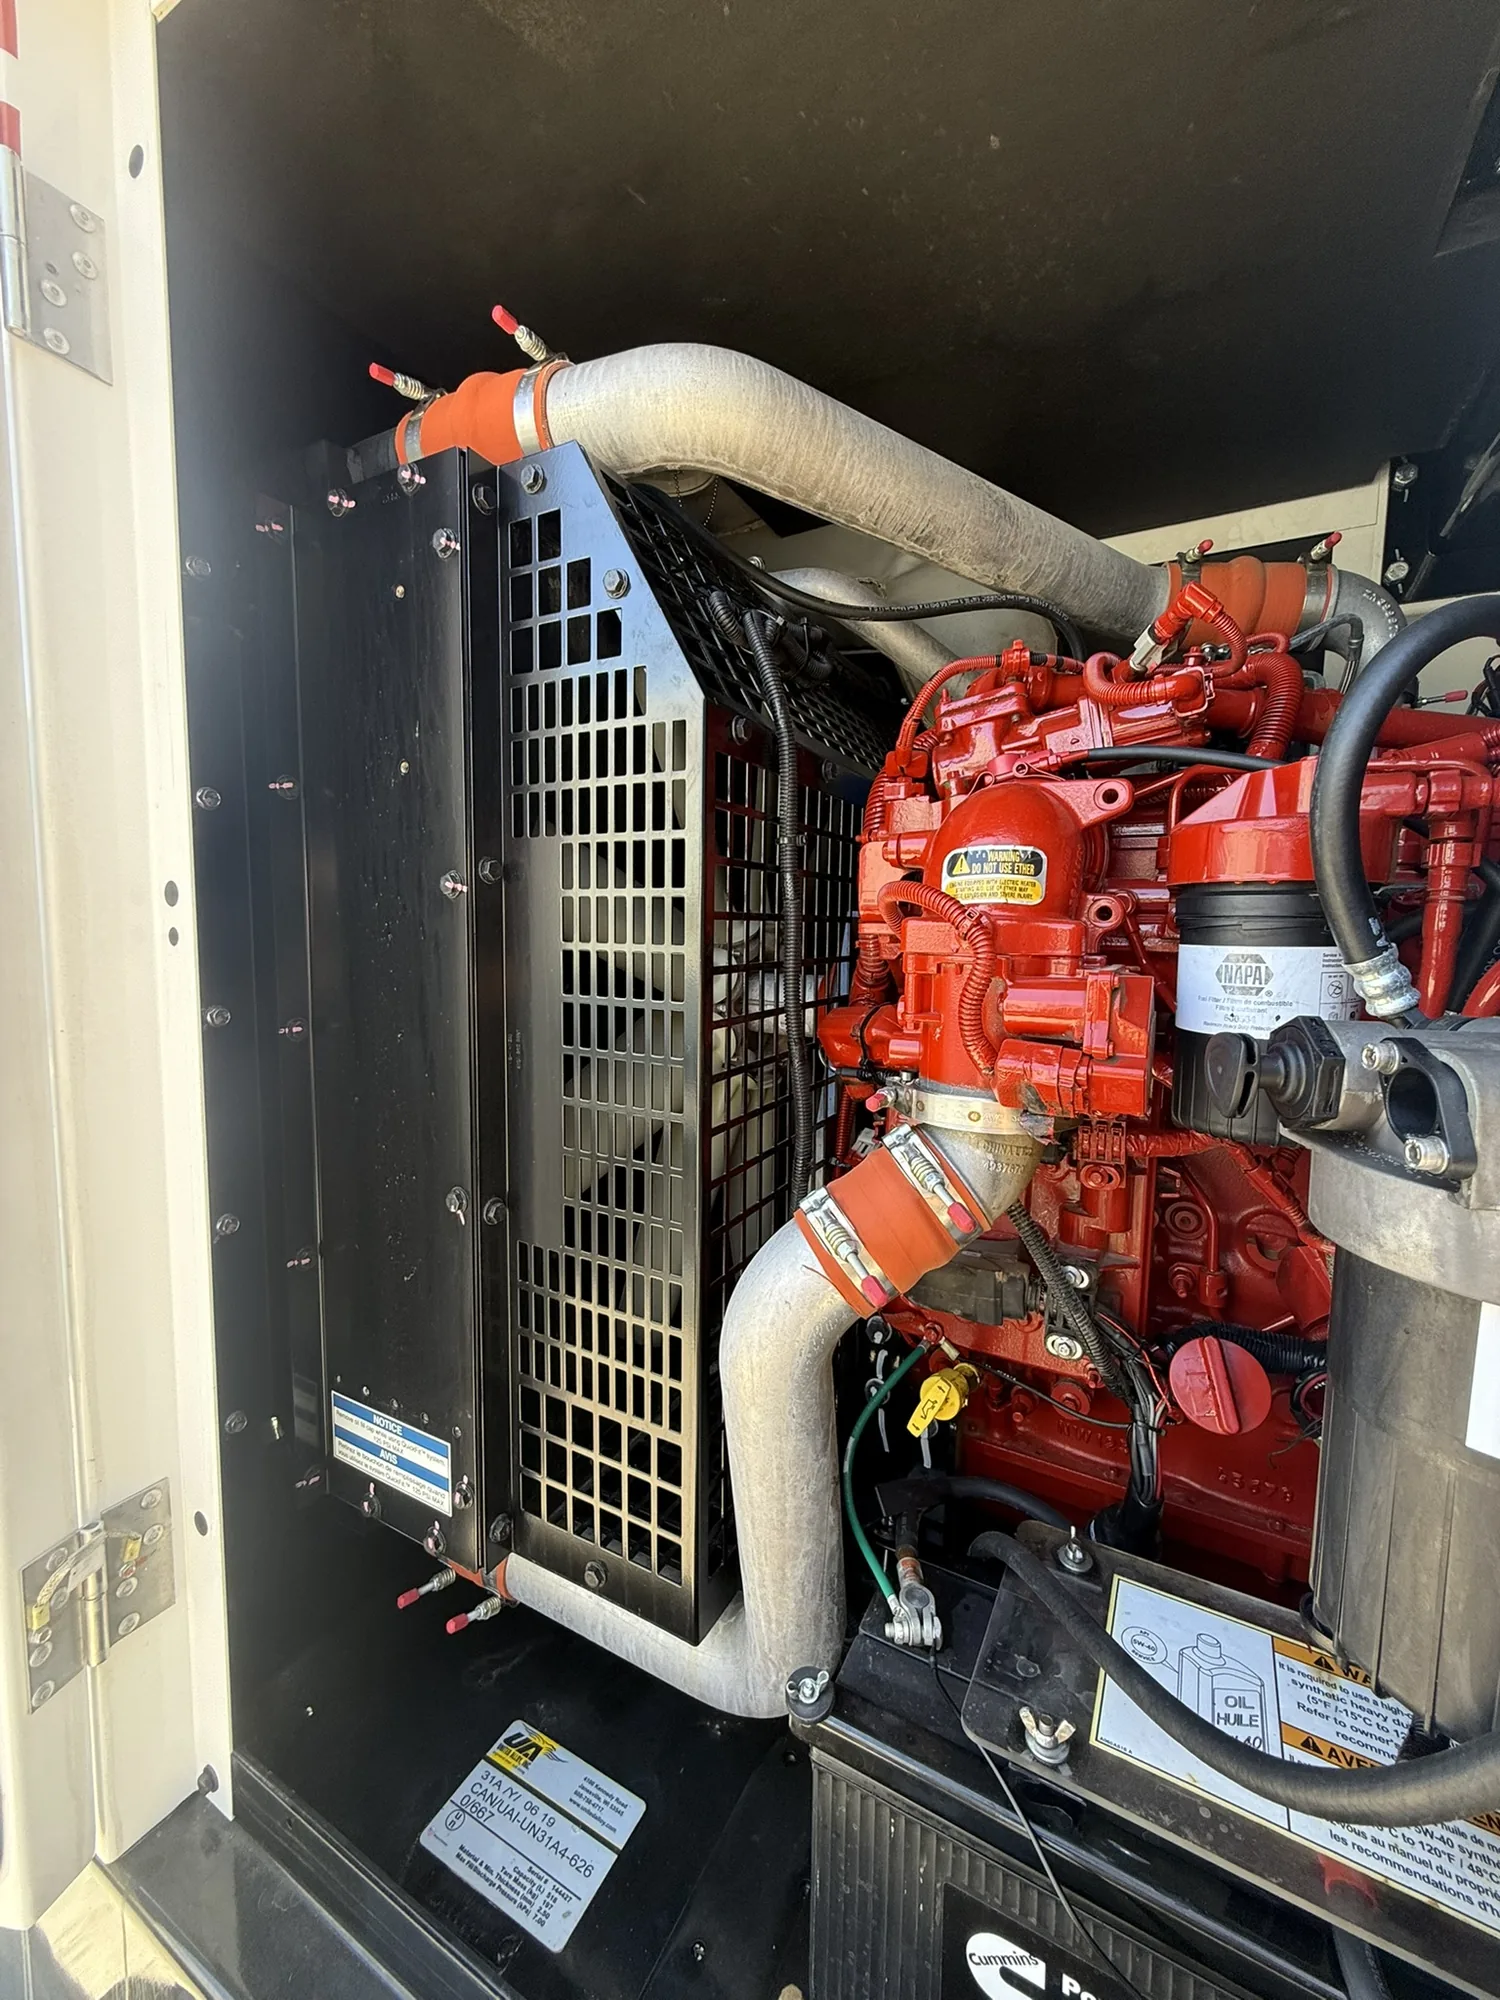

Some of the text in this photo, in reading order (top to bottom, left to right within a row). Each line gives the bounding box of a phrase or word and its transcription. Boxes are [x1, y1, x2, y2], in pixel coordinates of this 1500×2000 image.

[971, 862, 1035, 875] DO NOT USE ETHER
[1224, 964, 1263, 985] NAPA
[373, 1414, 402, 1436] NOTICE
[379, 1447, 397, 1465] AVIS
[1278, 1661, 1285, 1669] It
[1287, 1664, 1295, 1674] is
[1297, 1669, 1337, 1690] required
[1339, 1684, 1349, 1695] to
[1352, 1691, 1369, 1703] use
[1372, 1699, 1379, 1707] a
[1224, 1695, 1255, 1710] OIL
[1291, 1678, 1348, 1704] synthetic
[1351, 1699, 1388, 1722] heavy
[1216, 1712, 1259, 1727] HUILE
[1296, 1701, 1330, 1721] Refer
[1333, 1716, 1347, 1728] to
[1376, 1722, 1390, 1733] to
[458, 1793, 495, 1825] 0/667
[479, 1769, 504, 1791] 31A
[522, 1800, 540, 1816] 06
[539, 1812, 556, 1828] 19
[614, 1796, 628, 1809] Road
[467, 1780, 596, 1879] CAN/UAI-UN31A4-626
[1329, 1829, 1348, 1846] les
[1470, 1834, 1485, 1847] de
[1370, 1835, 1386, 1848] au
[1388, 1843, 1433, 1871] manuel
[1436, 1864, 1452, 1879] du
[1401, 1833, 1415, 1846] to
[1418, 1840, 1456, 1864] 120°F
[454, 1852, 467, 1864] Max
[495, 1884, 518, 1905] Pressure
[457, 1844, 479, 1863] Material
[493, 1872, 521, 1897] Thickness
[498, 1866, 513, 1880] Tare
[511, 1876, 528, 1891] Mass
[511, 1866, 537, 1888] Capacity
[526, 1866, 545, 1882] Serial
[969, 1951, 1039, 1967] Cummins
